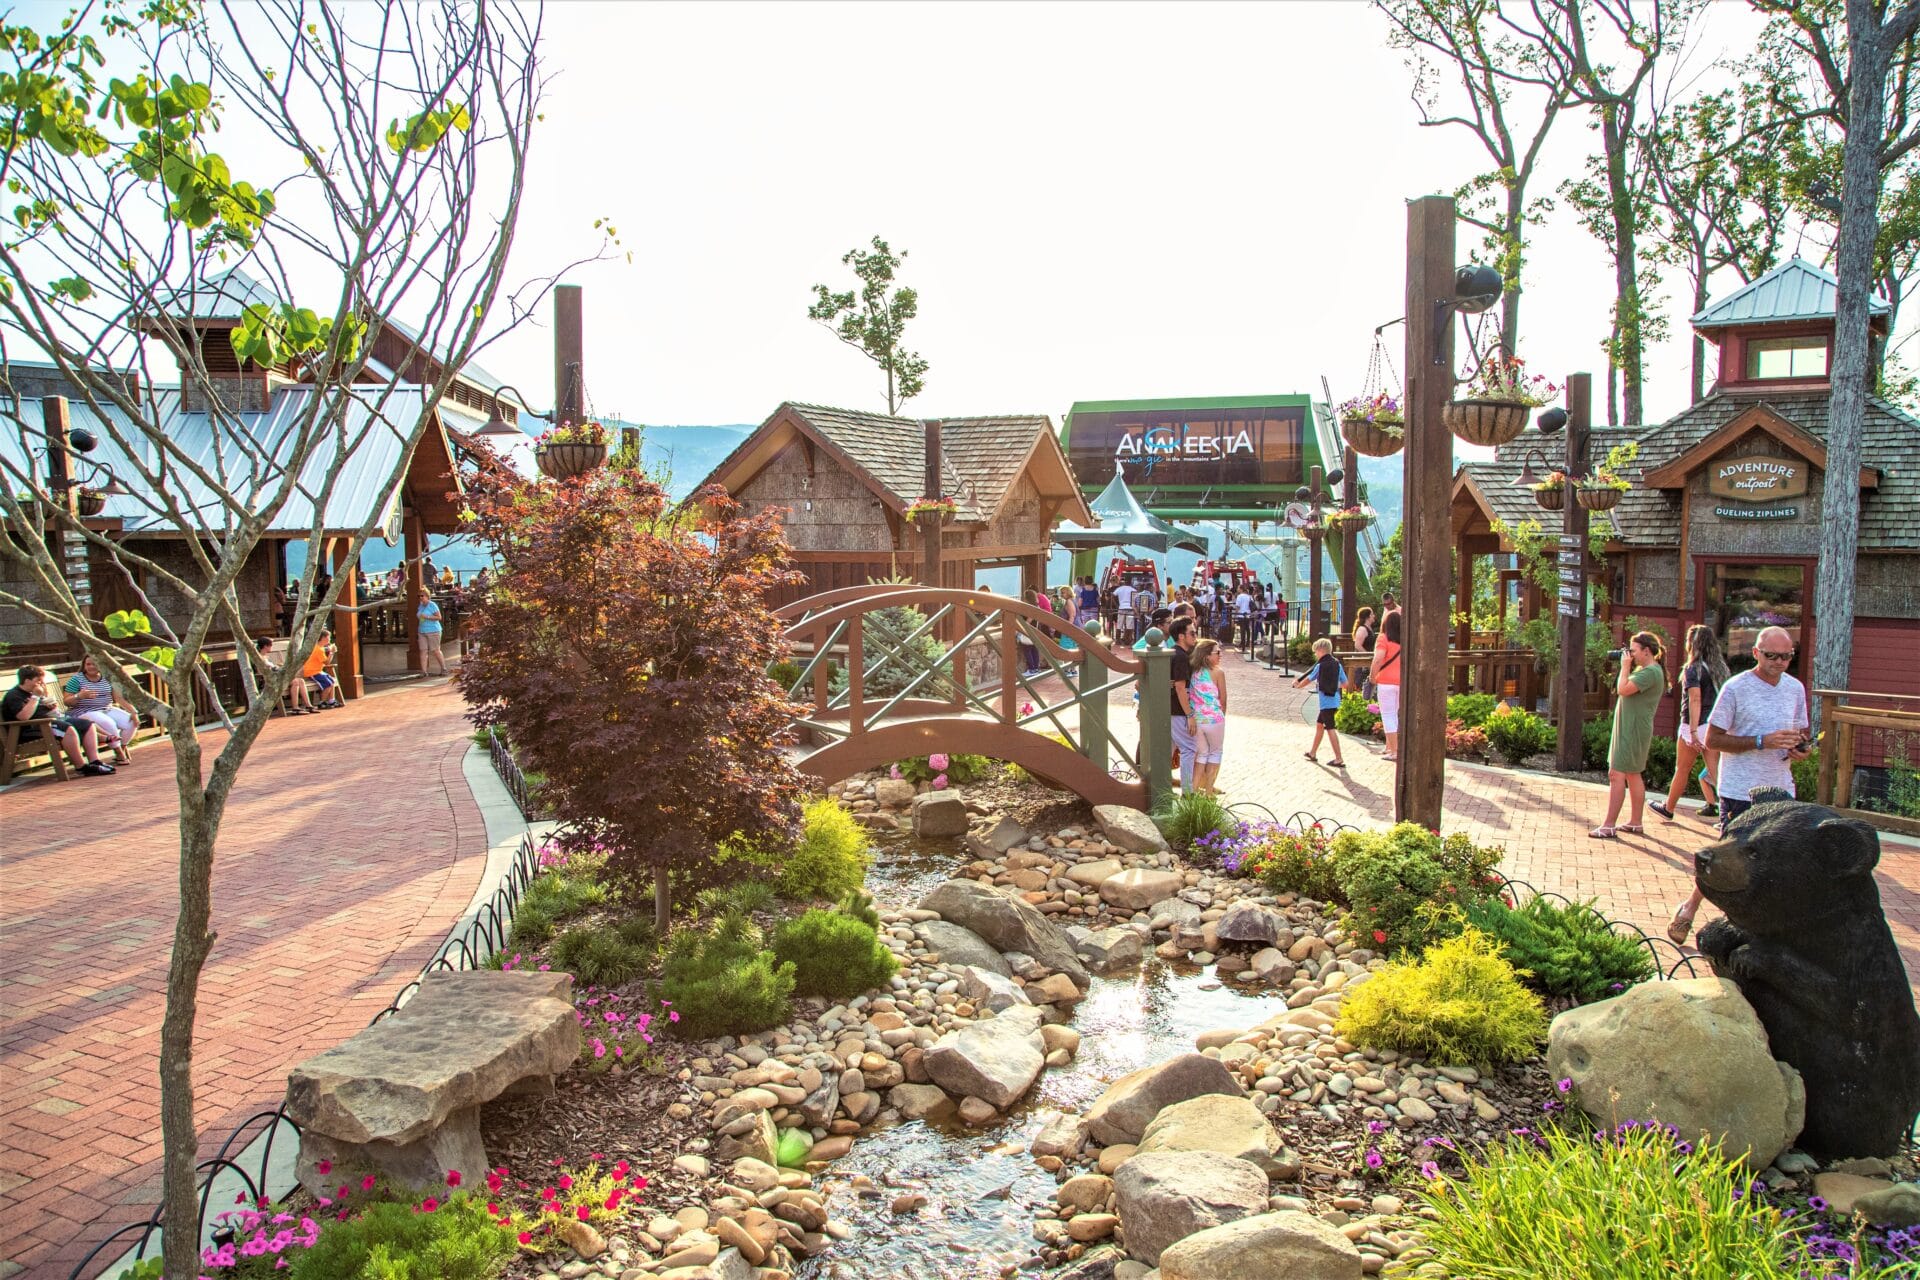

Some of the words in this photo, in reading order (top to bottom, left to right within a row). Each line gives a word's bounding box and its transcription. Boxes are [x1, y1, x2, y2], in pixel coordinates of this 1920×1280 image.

[1115, 429, 1254, 459] ANAKEESTA
[1719, 462, 1795, 479] ADVENTURE
[1736, 476, 1778, 493] outpost
[1716, 507, 1754, 518] DUELING
[1756, 508, 1795, 518] ZIPLINES
